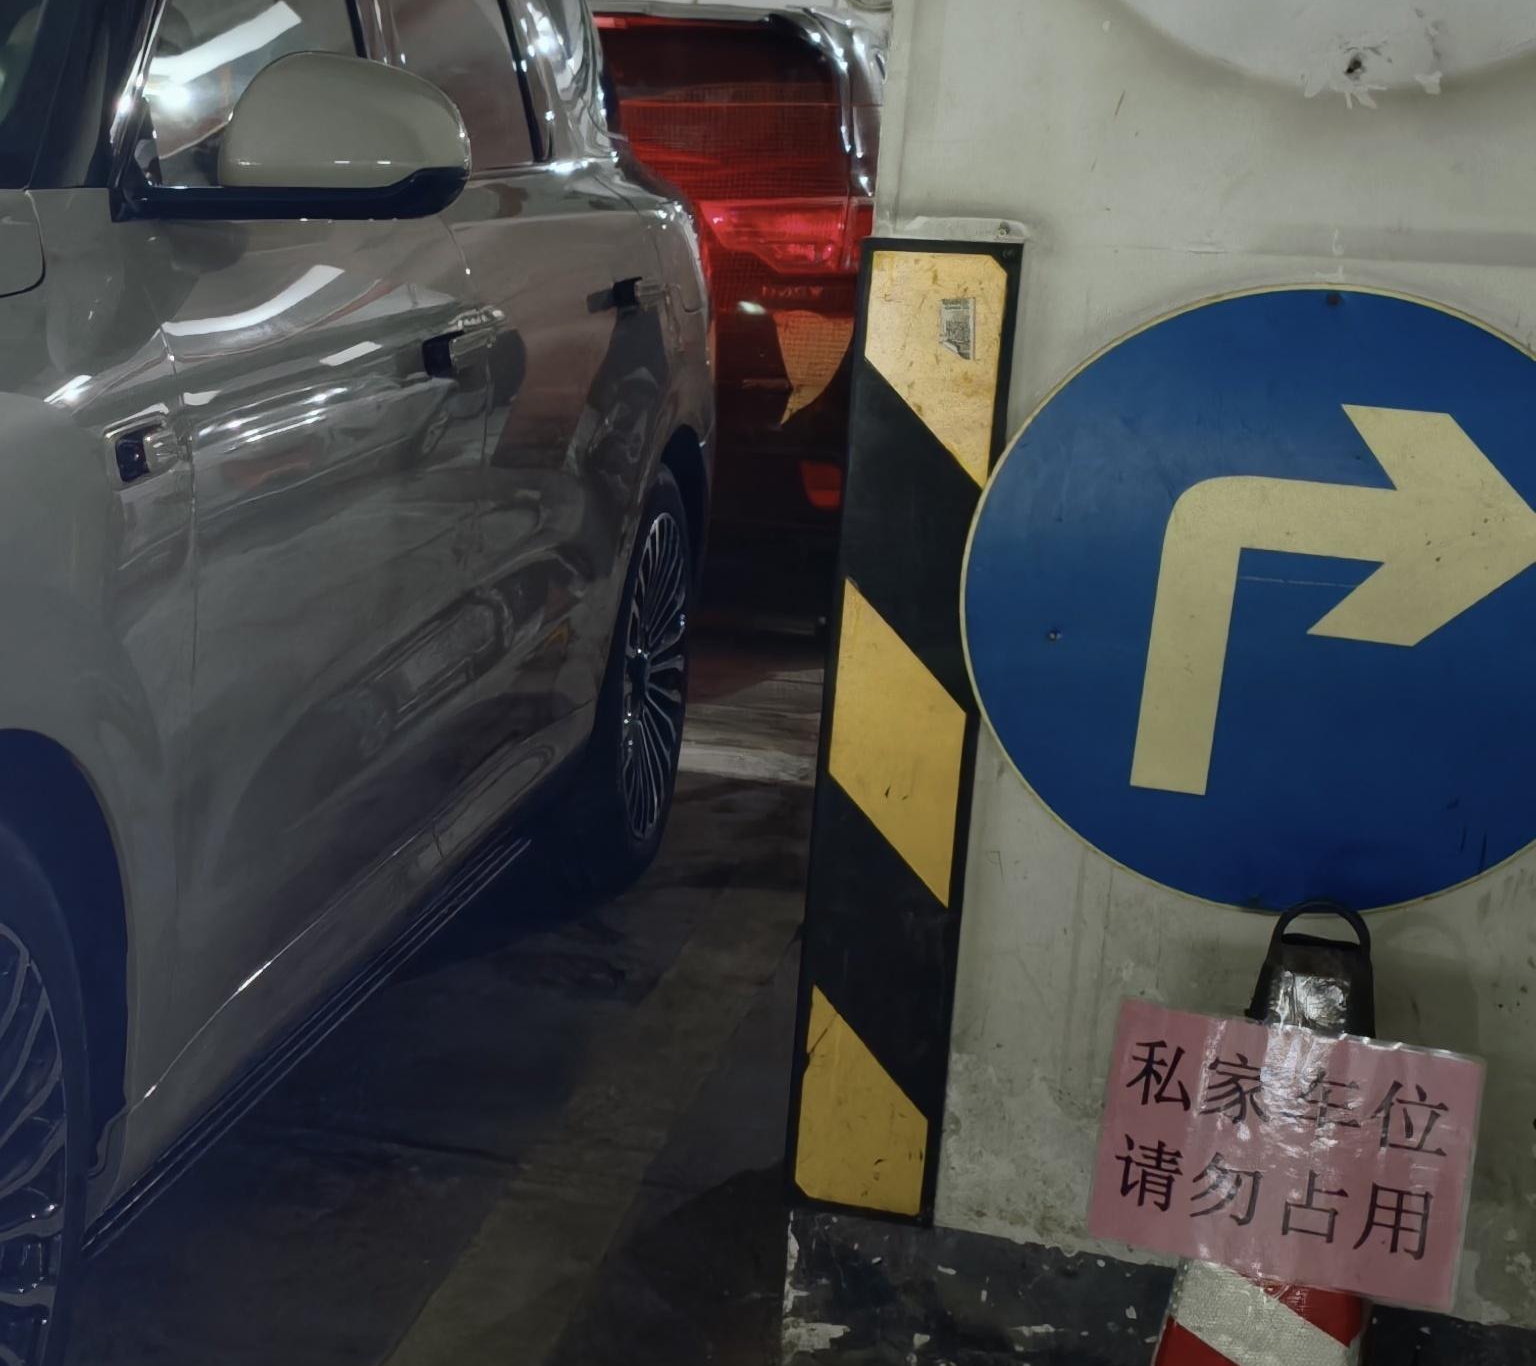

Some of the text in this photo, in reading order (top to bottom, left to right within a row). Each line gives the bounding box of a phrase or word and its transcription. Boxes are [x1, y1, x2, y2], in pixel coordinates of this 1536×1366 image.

[1125, 1039, 1450, 1158] 私家车位
[1114, 1133, 1435, 1261] 请勿占用
